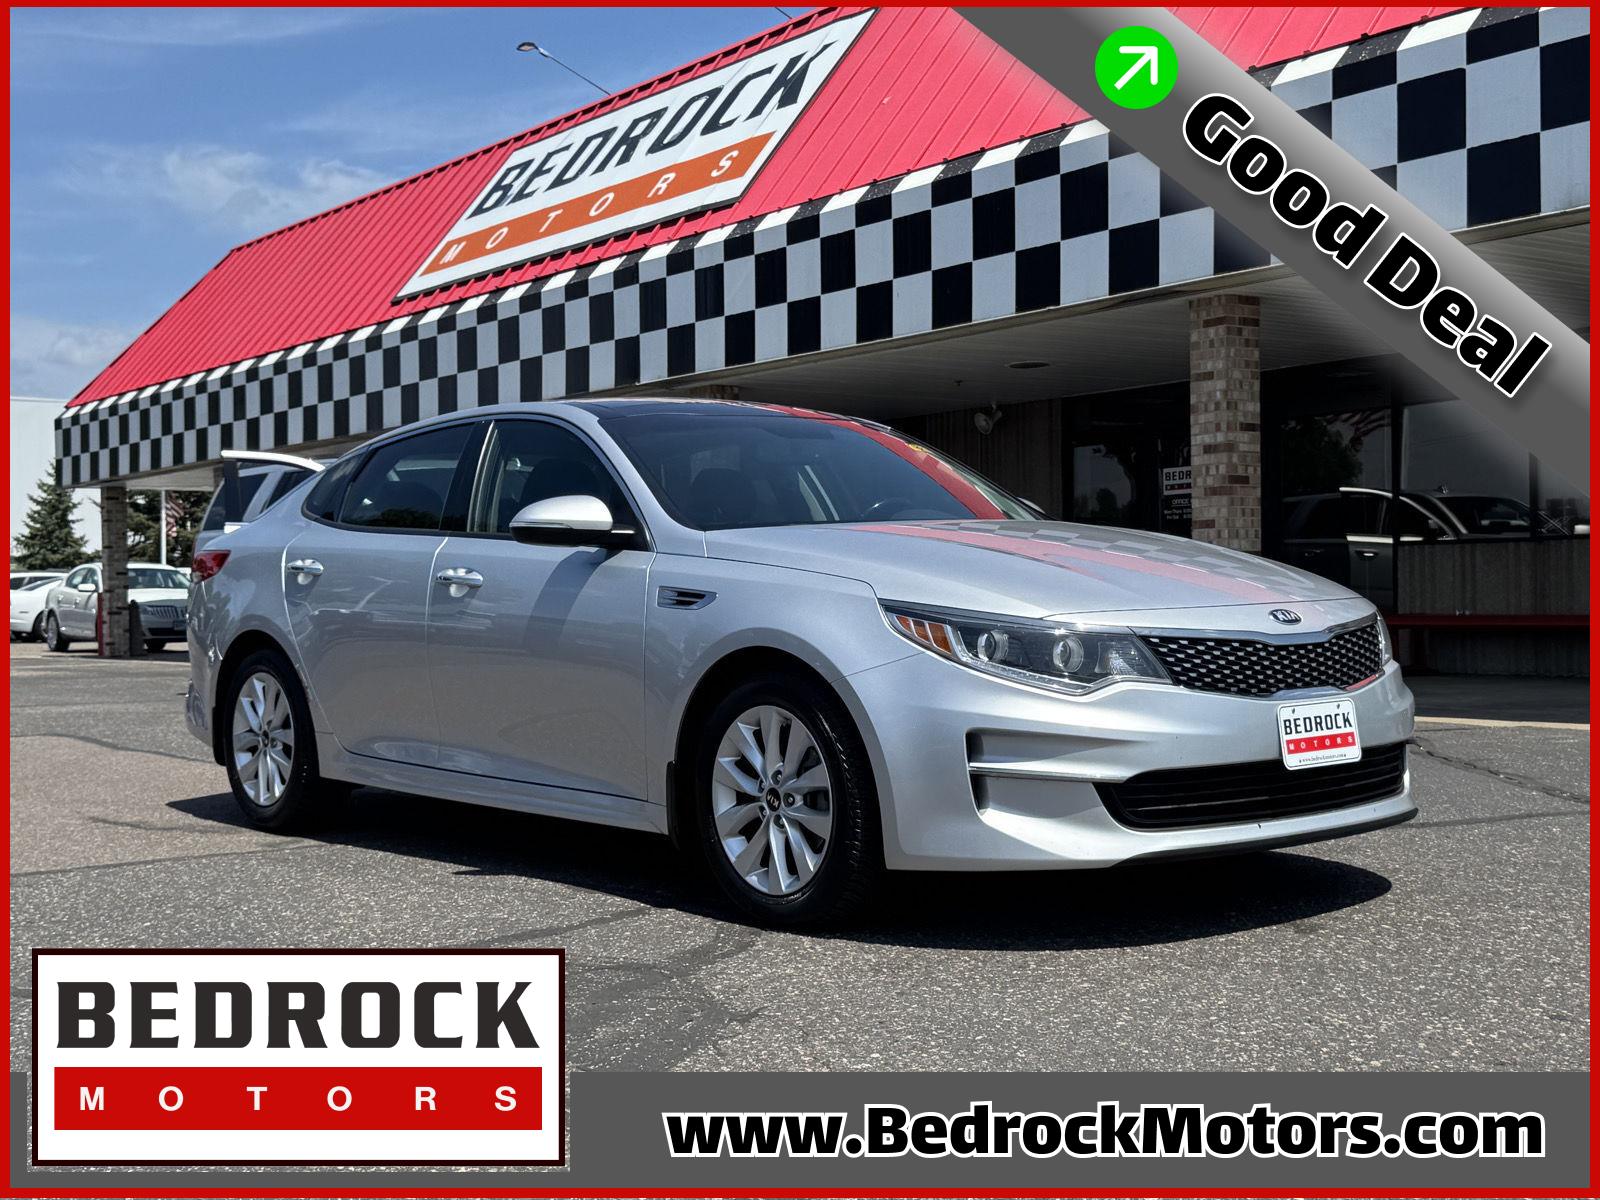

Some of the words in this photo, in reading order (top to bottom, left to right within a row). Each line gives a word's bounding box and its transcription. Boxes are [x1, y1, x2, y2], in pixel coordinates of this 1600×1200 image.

[467, 41, 838, 219] BEDROCK
[439, 150, 738, 265] MOTORS
[1165, 470, 1192, 481] BEDR
[1272, 610, 1301, 621] KIA
[1283, 711, 1353, 735] BEDROCK
[1289, 735, 1353, 750] MOTORS
